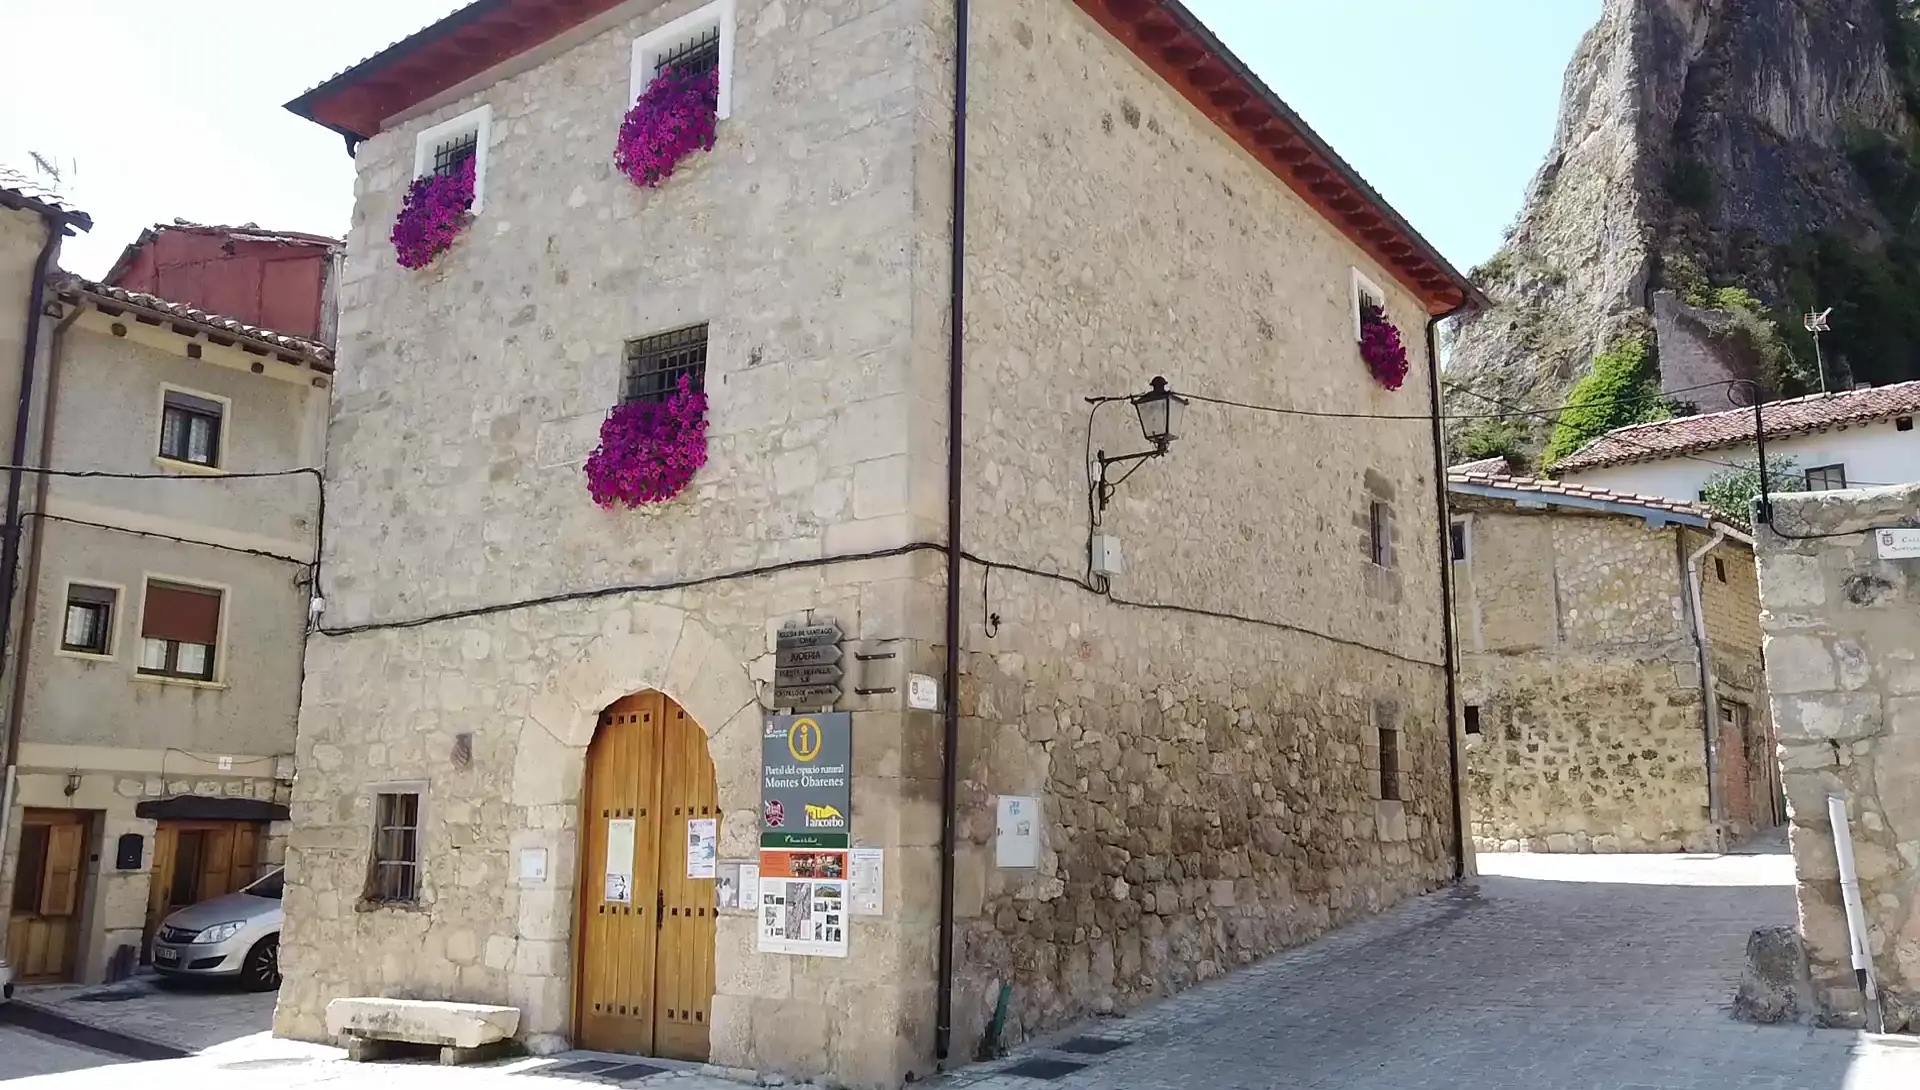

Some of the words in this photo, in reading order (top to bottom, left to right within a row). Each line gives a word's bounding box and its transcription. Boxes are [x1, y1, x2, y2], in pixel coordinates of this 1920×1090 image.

[765, 765, 785, 775] Portal
[785, 764, 796, 774] del
[796, 766, 820, 777] espacio
[821, 764, 844, 774] natural
[765, 777, 799, 788] Montes
[801, 776, 844, 787] Obarenes
